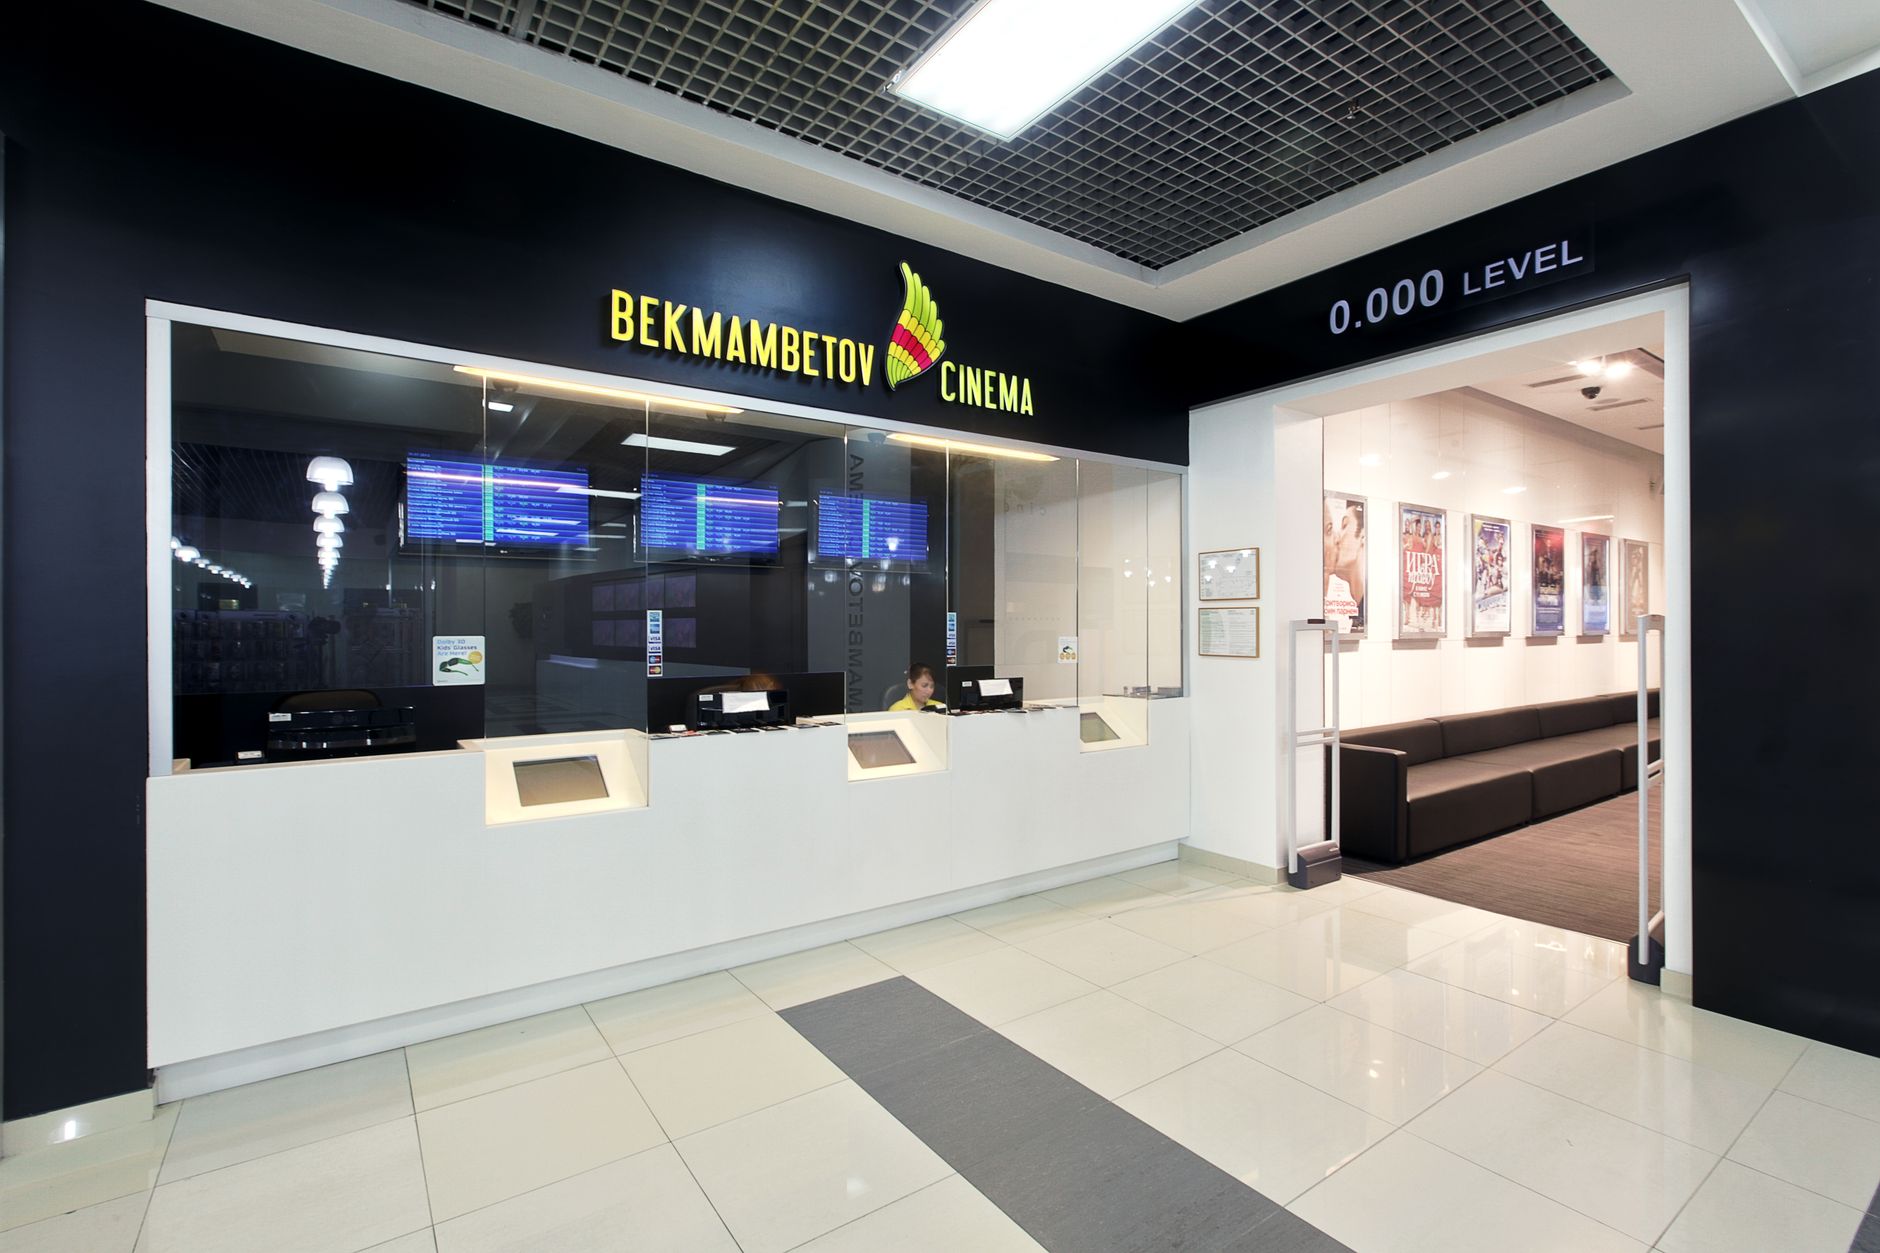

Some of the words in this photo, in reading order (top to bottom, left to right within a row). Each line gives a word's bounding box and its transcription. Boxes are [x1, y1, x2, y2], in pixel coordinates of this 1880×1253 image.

[1329, 269, 1444, 335] 0.000
[1463, 240, 1584, 296] LEVEL
[610, 288, 875, 386] BEKMAMBETOV
[940, 360, 1034, 416] CINEMA
